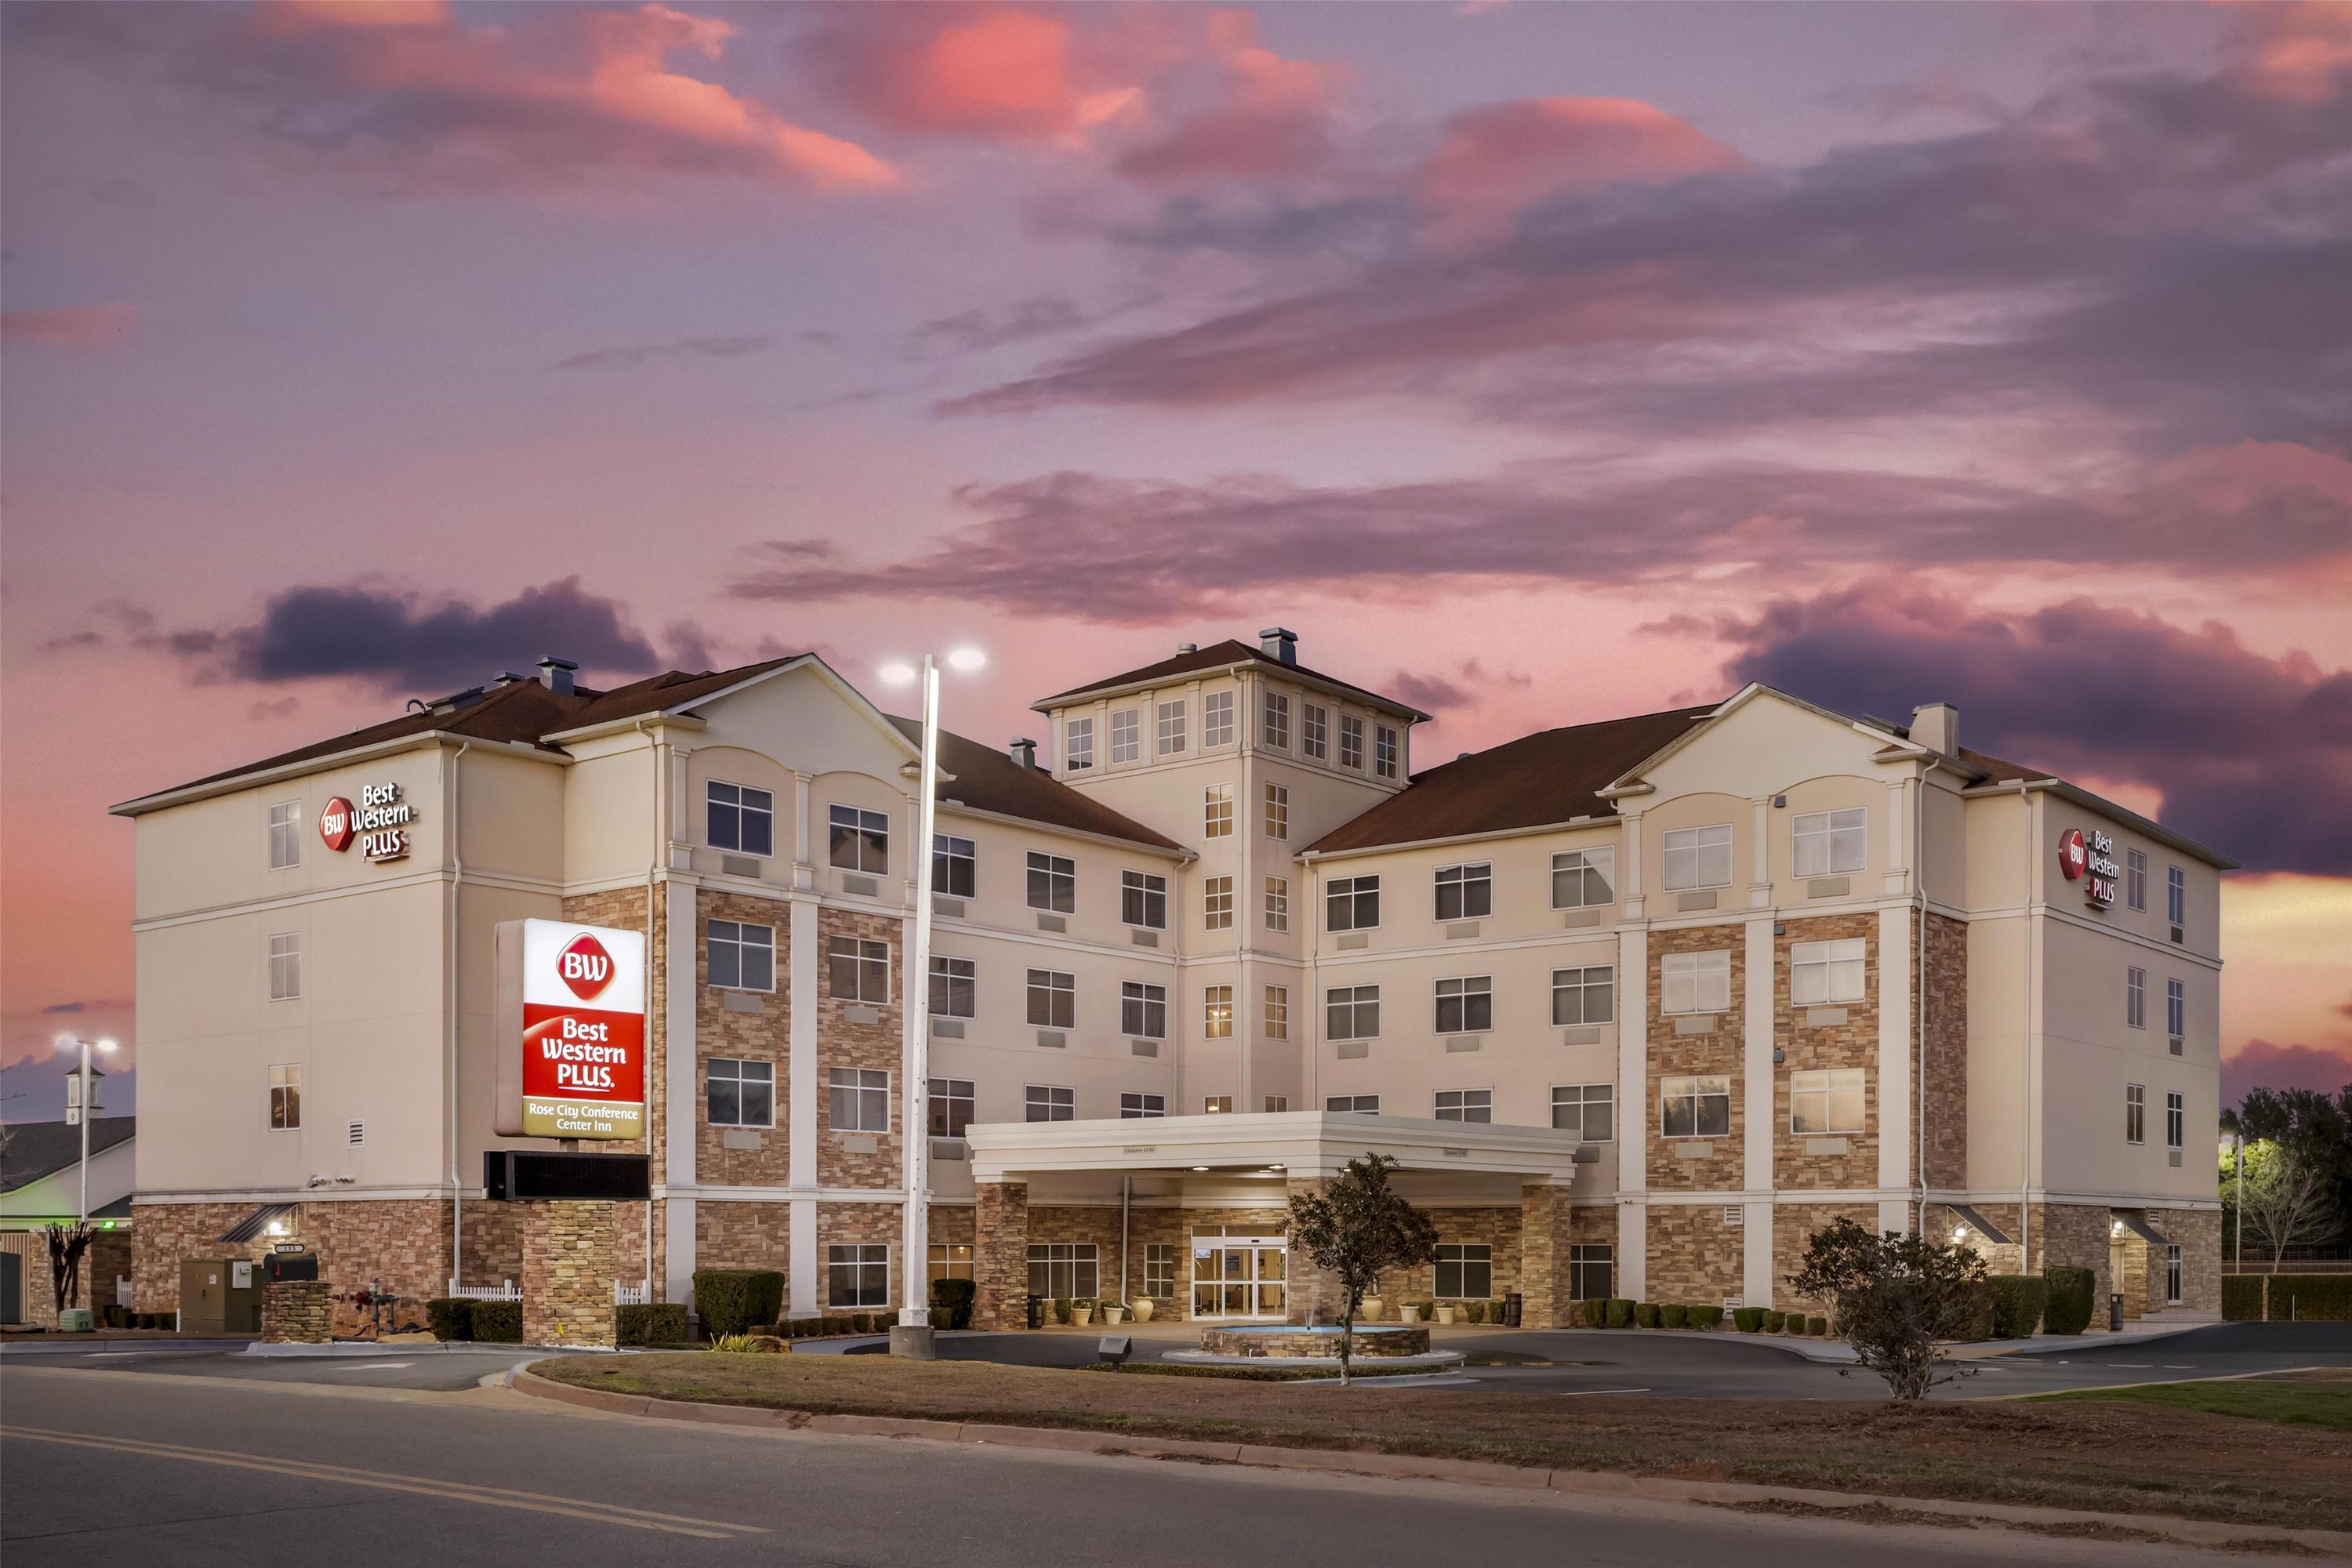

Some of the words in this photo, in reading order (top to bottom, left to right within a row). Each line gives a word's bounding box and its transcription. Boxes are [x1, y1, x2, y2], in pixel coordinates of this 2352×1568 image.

[363, 782, 394, 807] Best
[324, 812, 345, 836] BW
[350, 804, 409, 832] Western
[363, 829, 401, 857] PLUS
[2071, 844, 2084, 865] BW
[2095, 830, 2112, 855] Best
[2089, 850, 2120, 879] Western
[2093, 878, 2114, 902] PLUS
[564, 952, 608, 982] BW
[563, 1018, 608, 1042] Best
[542, 1037, 626, 1064] Western
[529, 1102, 555, 1115] Rose
[557, 1104, 579, 1119] City
[581, 1105, 638, 1120] Conference
[556, 1118, 592, 1130] Center
[594, 1120, 612, 1132] Inn
